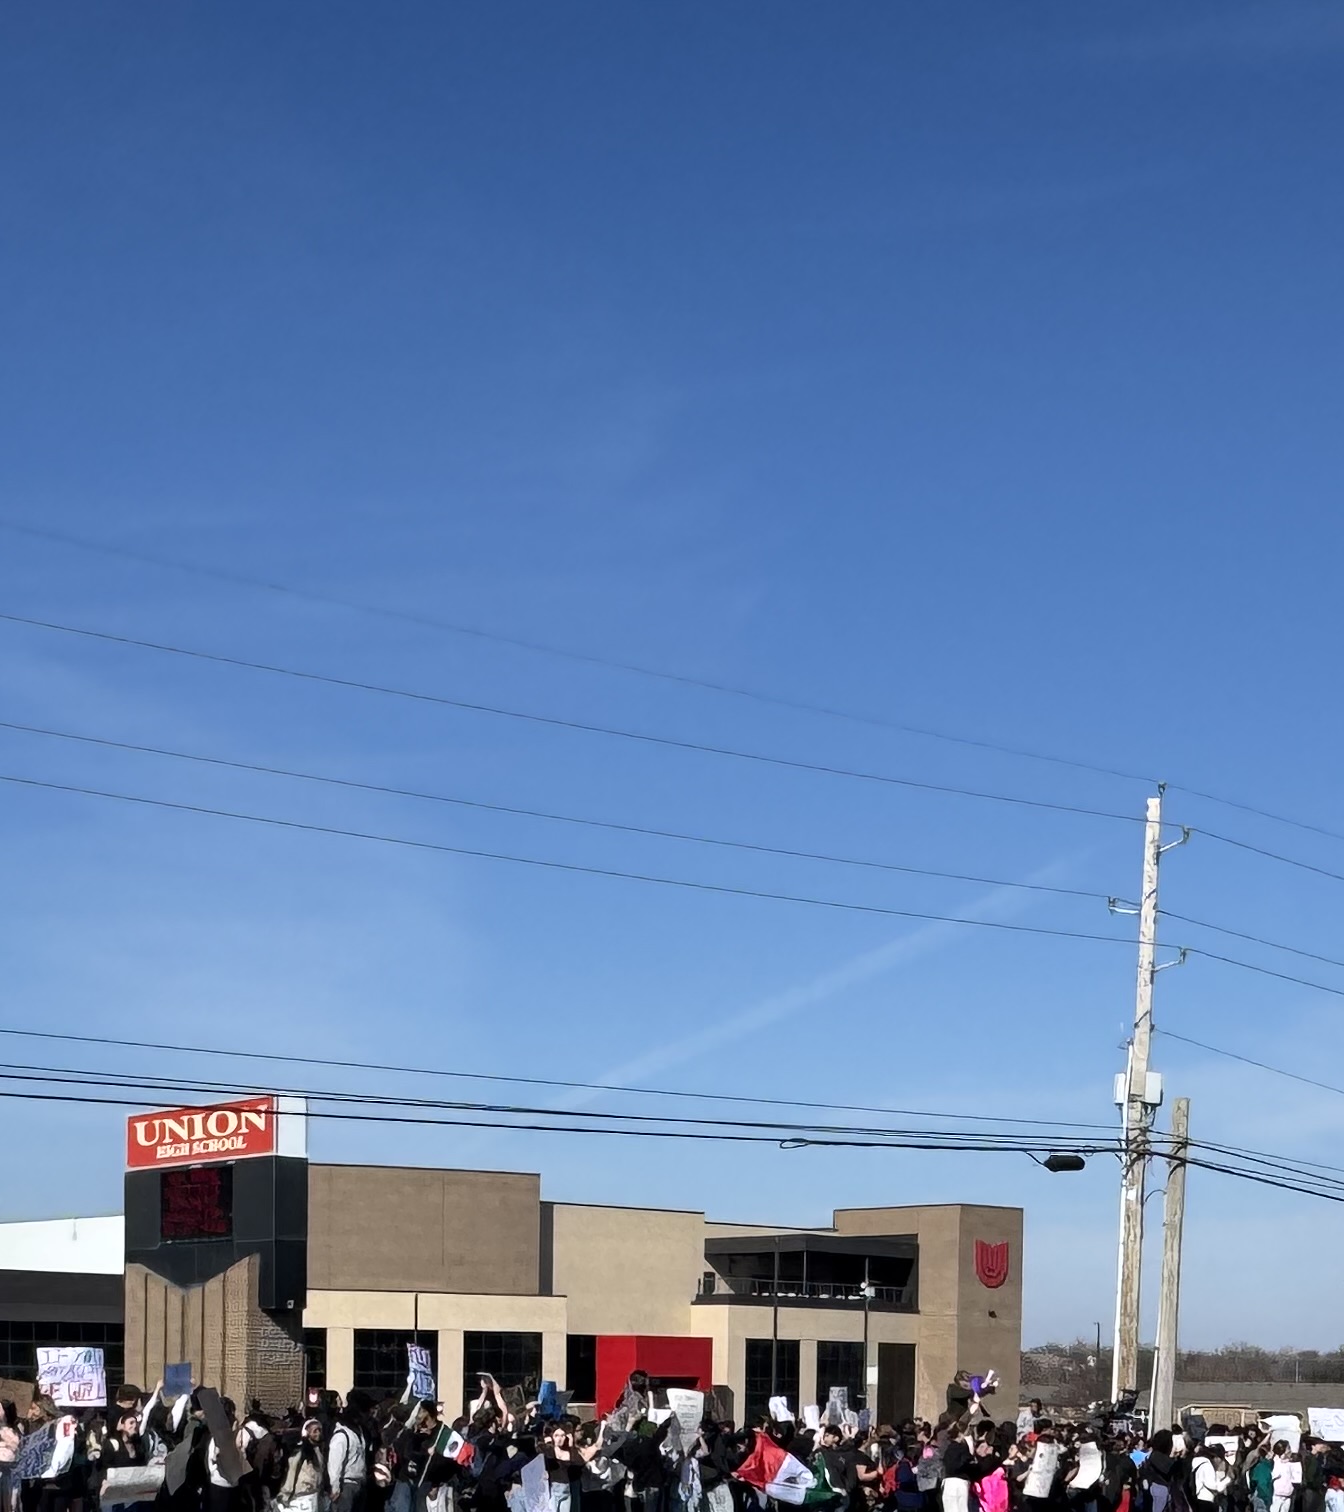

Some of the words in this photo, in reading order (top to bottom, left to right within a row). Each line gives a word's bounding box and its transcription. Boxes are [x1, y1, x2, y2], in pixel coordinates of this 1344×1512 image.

[134, 1104, 269, 1147] UNION
[156, 1142, 190, 1159] HIGH
[191, 1135, 248, 1155] SCHOOL
